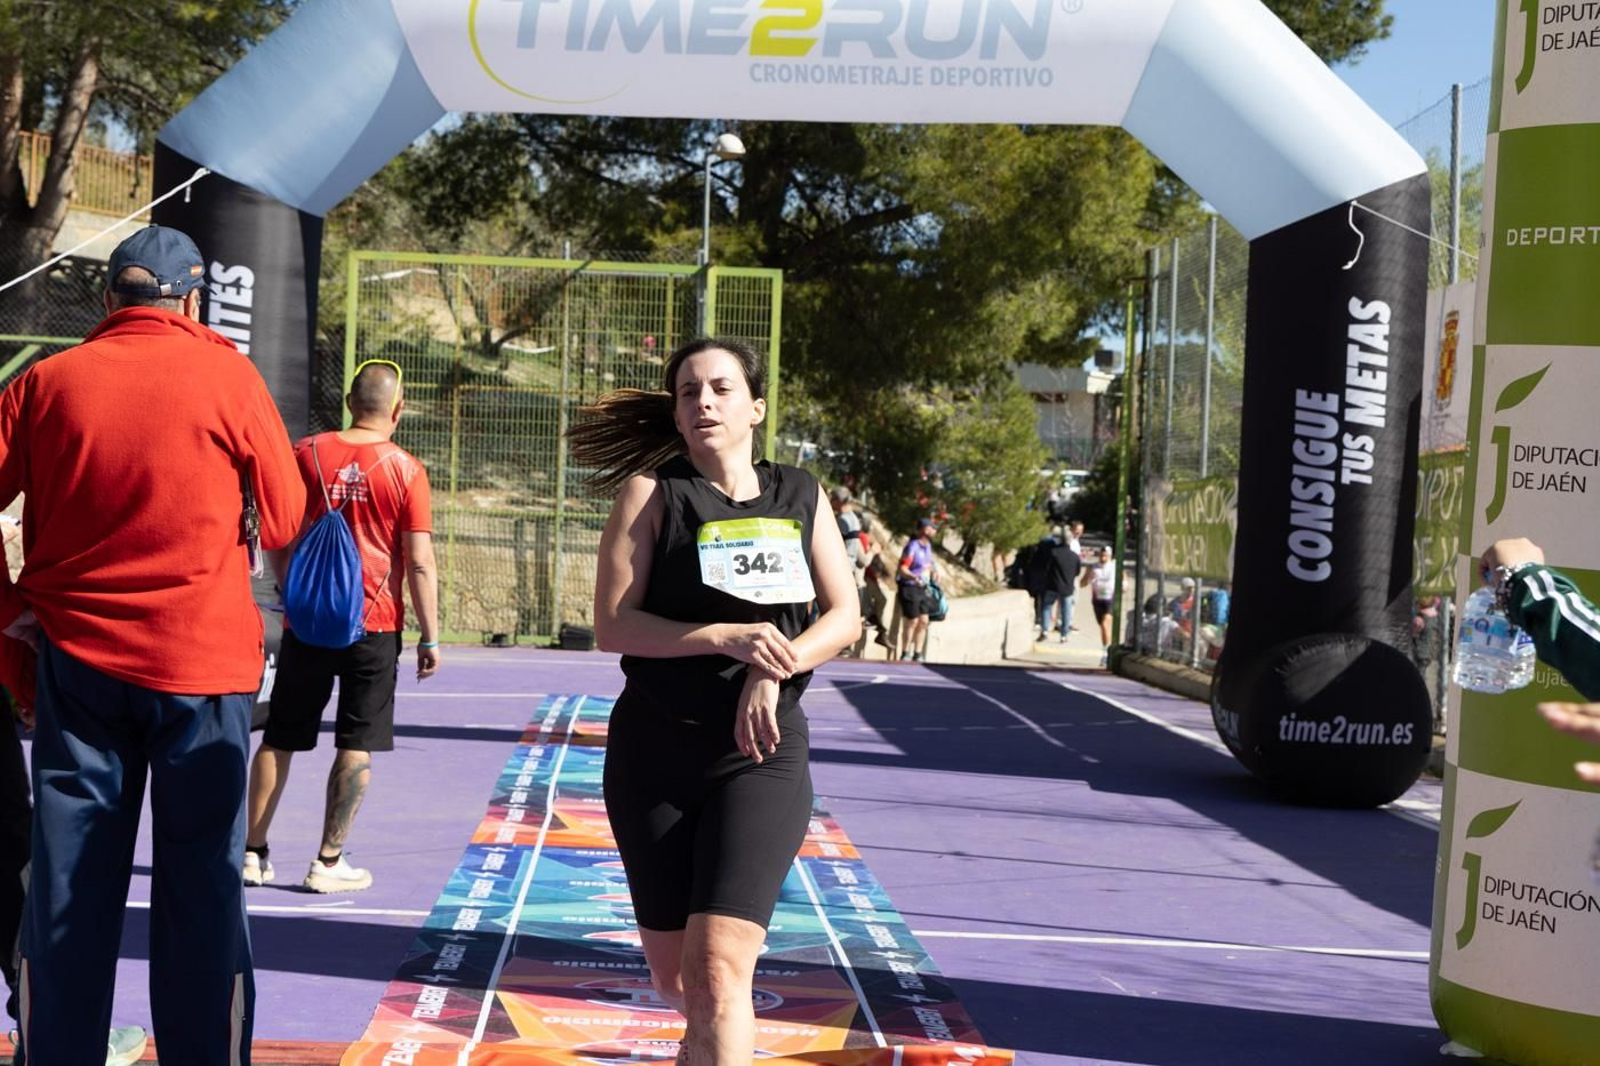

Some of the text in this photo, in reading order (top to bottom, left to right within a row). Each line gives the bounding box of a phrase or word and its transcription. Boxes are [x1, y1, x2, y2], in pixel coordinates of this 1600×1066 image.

[503, 0, 1053, 62] TIME2RUN
[1542, 32, 1564, 51] DE
[749, 63, 1054, 88] CRONOMETRAJE DEPORTIVO
[1507, 226, 1600, 246] DEPORT
[1340, 296, 1392, 485] TUS METAS
[1513, 444, 1600, 467] DIPUTACI
[1285, 388, 1340, 583] CONSIGUE
[1512, 470, 1587, 493] DE JAÉN
[733, 552, 784, 575] 342
[1279, 712, 1415, 745] time2run.es
[1484, 875, 1600, 912] DIPUTACIÓN
[1482, 901, 1556, 934] DE JAÉN
